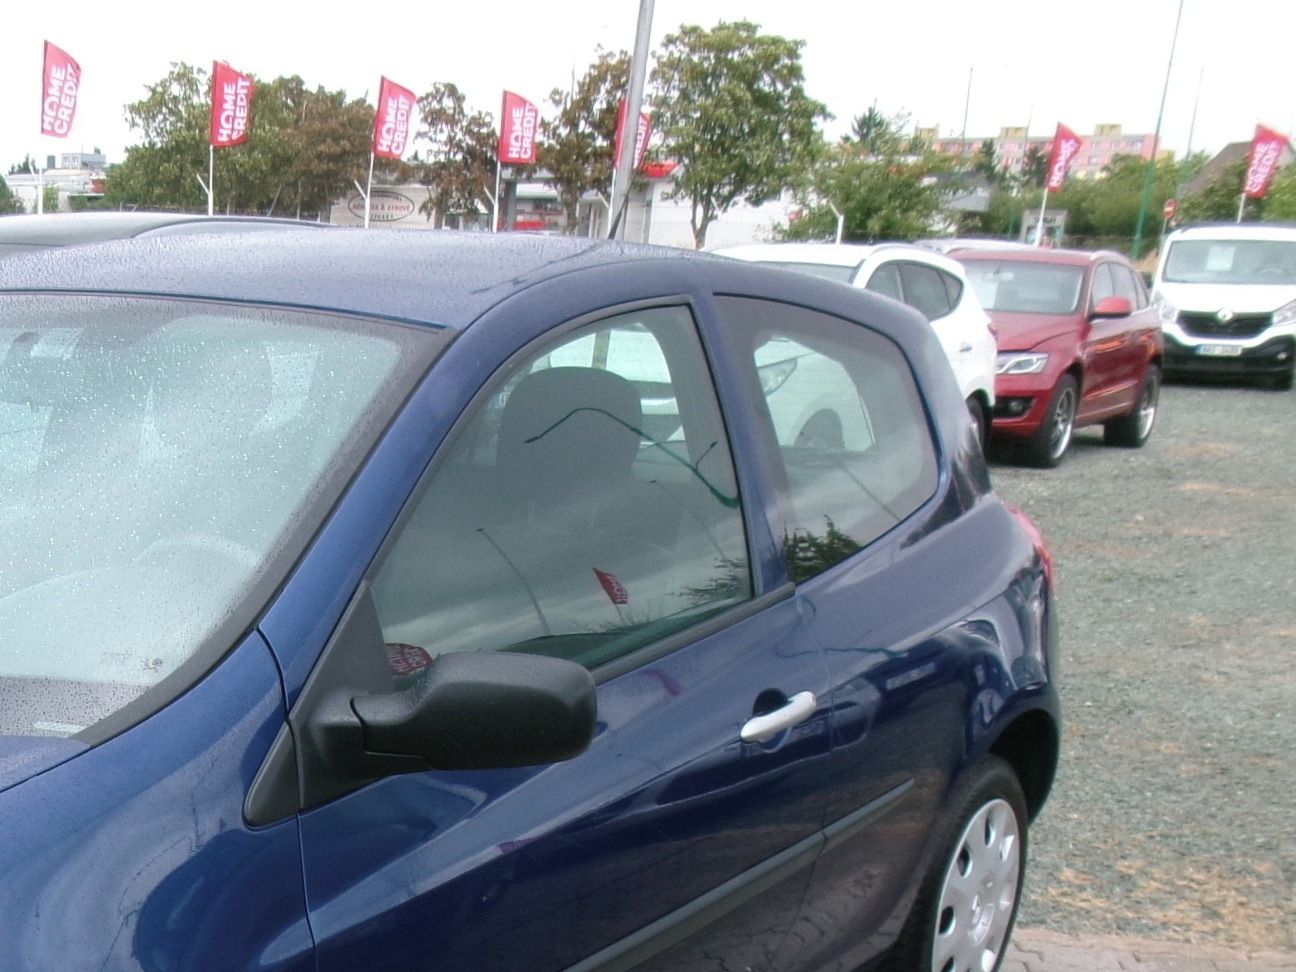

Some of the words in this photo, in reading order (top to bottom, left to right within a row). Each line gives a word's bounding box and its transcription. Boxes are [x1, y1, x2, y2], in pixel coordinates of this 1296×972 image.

[43, 65, 65, 131] HOME
[54, 62, 78, 135] CREDIT
[217, 82, 236, 142] HOME
[231, 77, 250, 140] CREDIT
[377, 96, 398, 152] HOME
[391, 94, 410, 155] CREDIT
[508, 107, 524, 158] HOME
[520, 101, 536, 159] CREDIT
